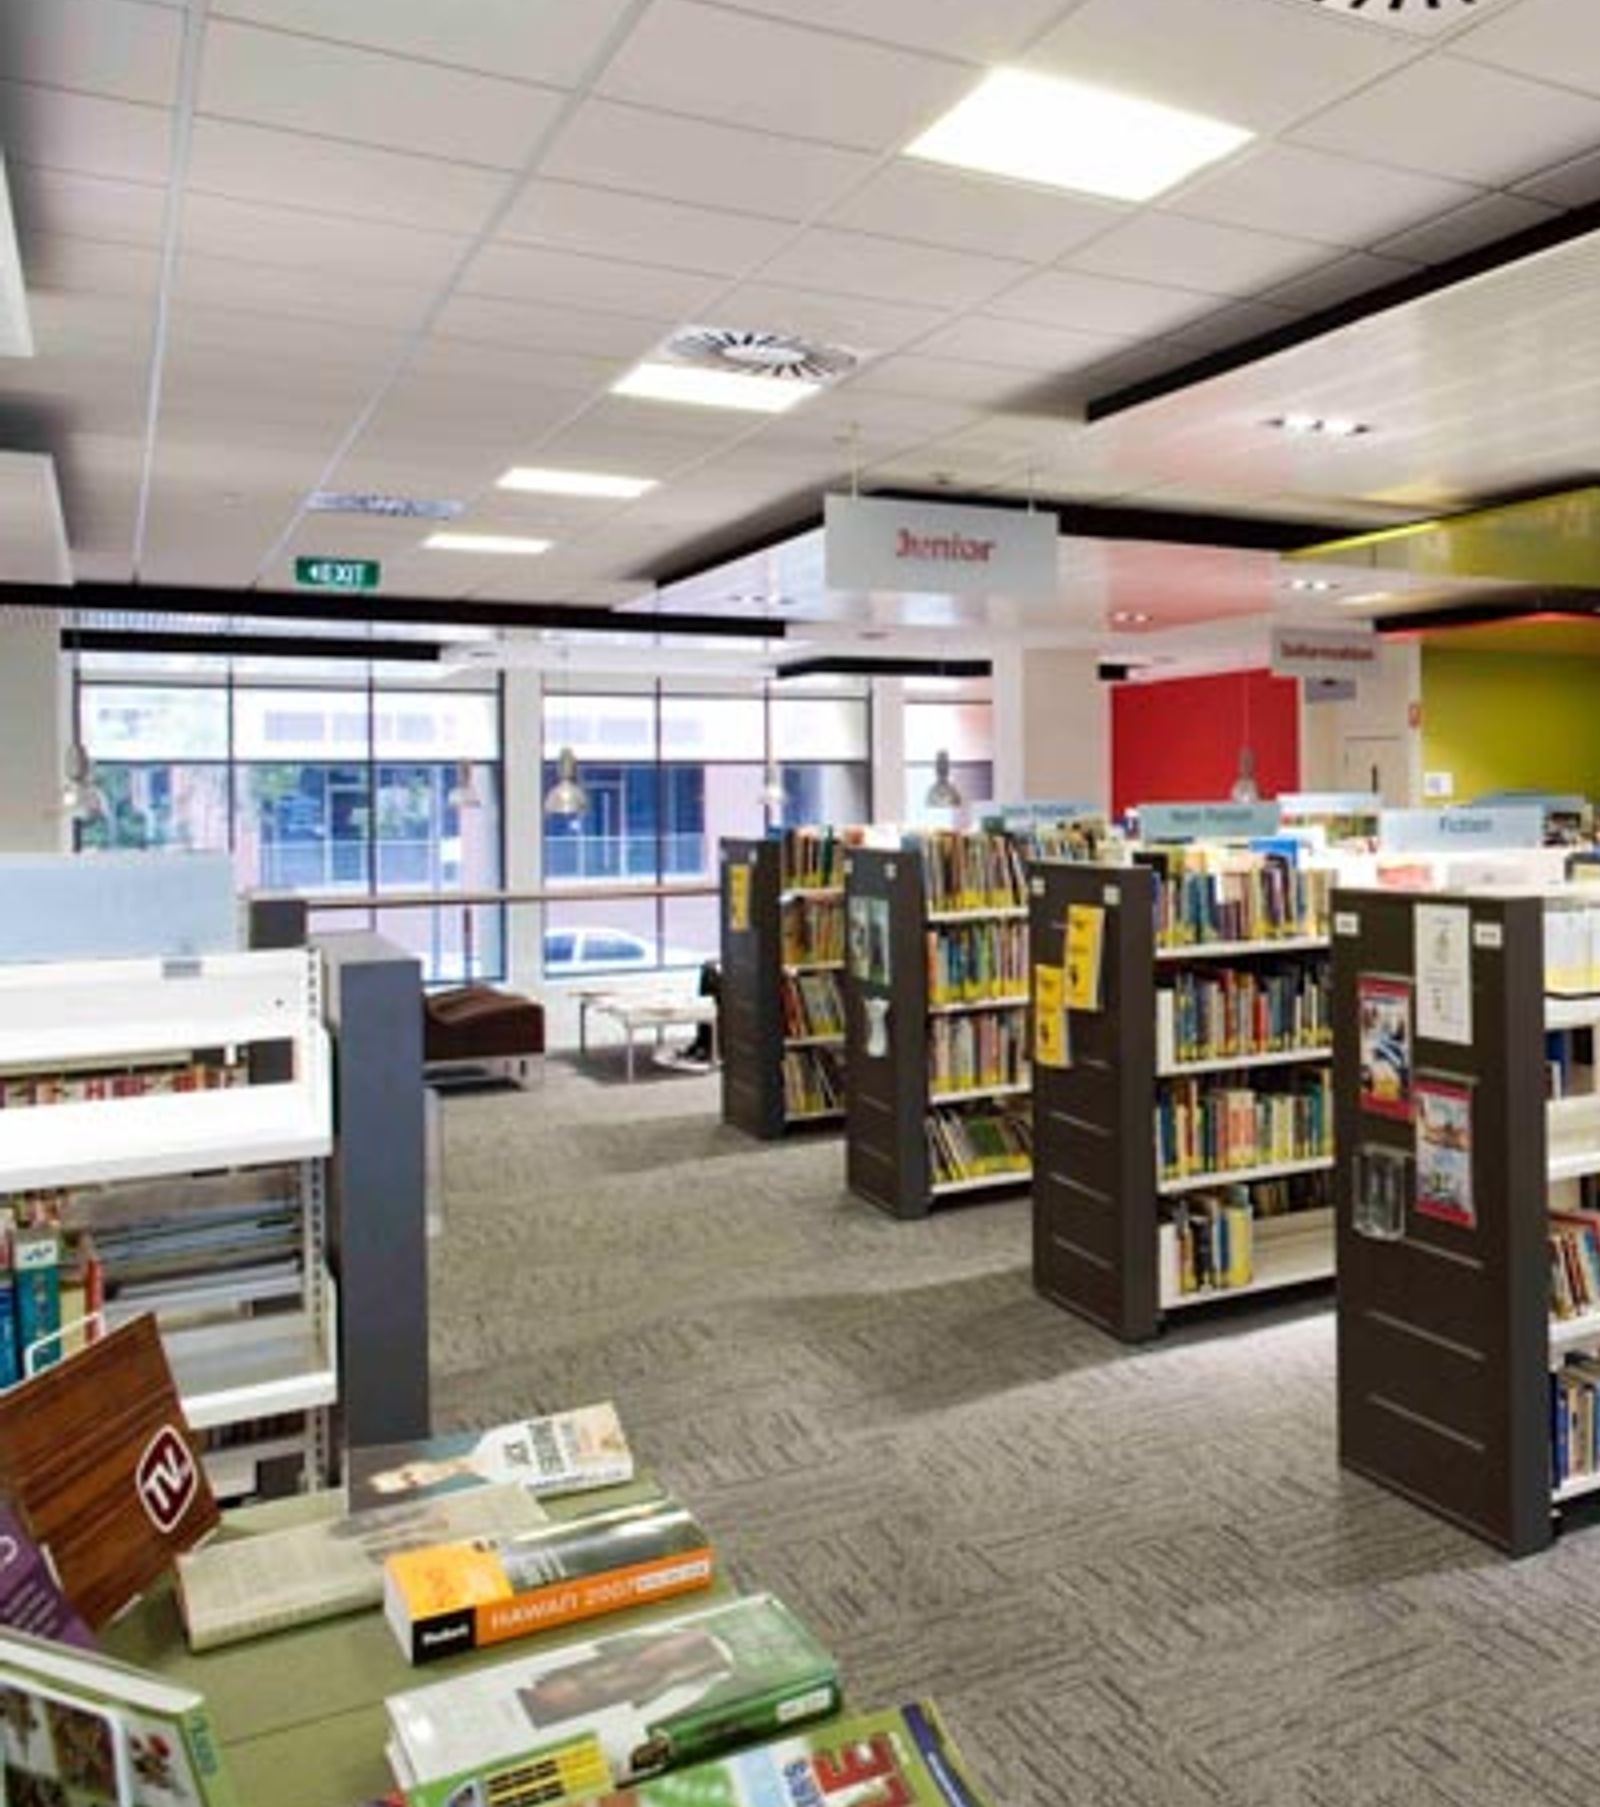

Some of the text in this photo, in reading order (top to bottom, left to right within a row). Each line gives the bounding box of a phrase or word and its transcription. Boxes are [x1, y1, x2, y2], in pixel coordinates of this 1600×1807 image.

[895, 527, 995, 562] Junior
[319, 563, 366, 585] EXIT
[1281, 640, 1375, 661] Information
[1439, 814, 1493, 833] Fiction
